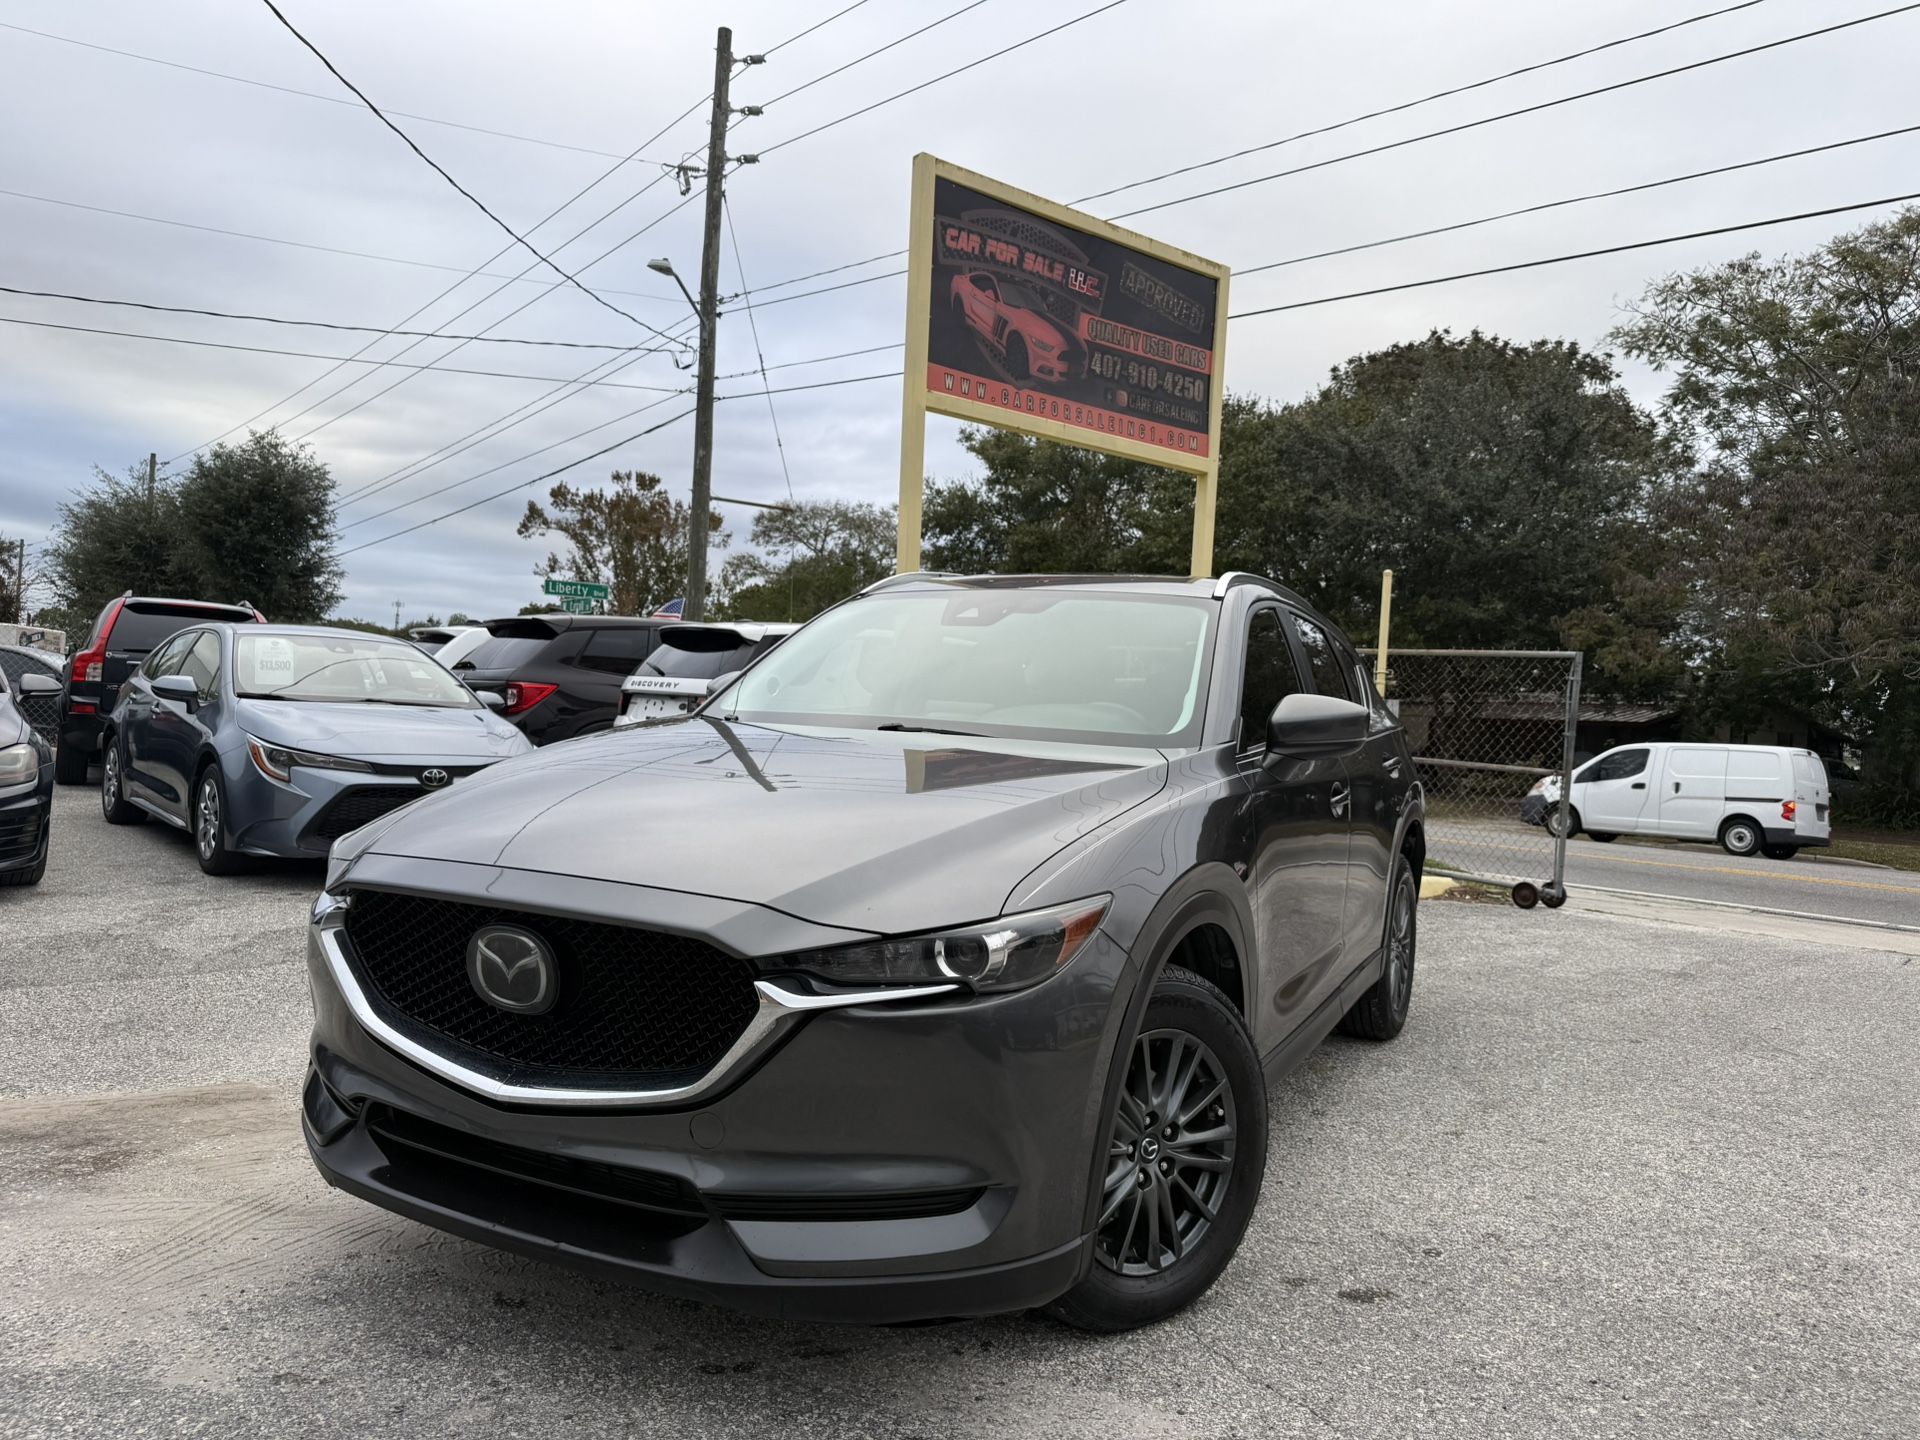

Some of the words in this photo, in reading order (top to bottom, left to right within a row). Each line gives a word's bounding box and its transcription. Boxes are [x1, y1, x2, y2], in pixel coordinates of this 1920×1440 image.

[945, 227, 979, 255] CAR
[985, 238, 1018, 266] FOR
[1022, 251, 1064, 282] SALE
[1069, 268, 1100, 298] LLC
[1126, 270, 1200, 328] APPROVED
[1088, 317, 1140, 352] QUALITY
[1141, 334, 1173, 361] USED
[1175, 342, 1206, 370] CARS
[1091, 351, 1204, 402] 407-910-4250
[549, 580, 589, 597] Liberty
[631, 680, 680, 689] DISCOVERY
